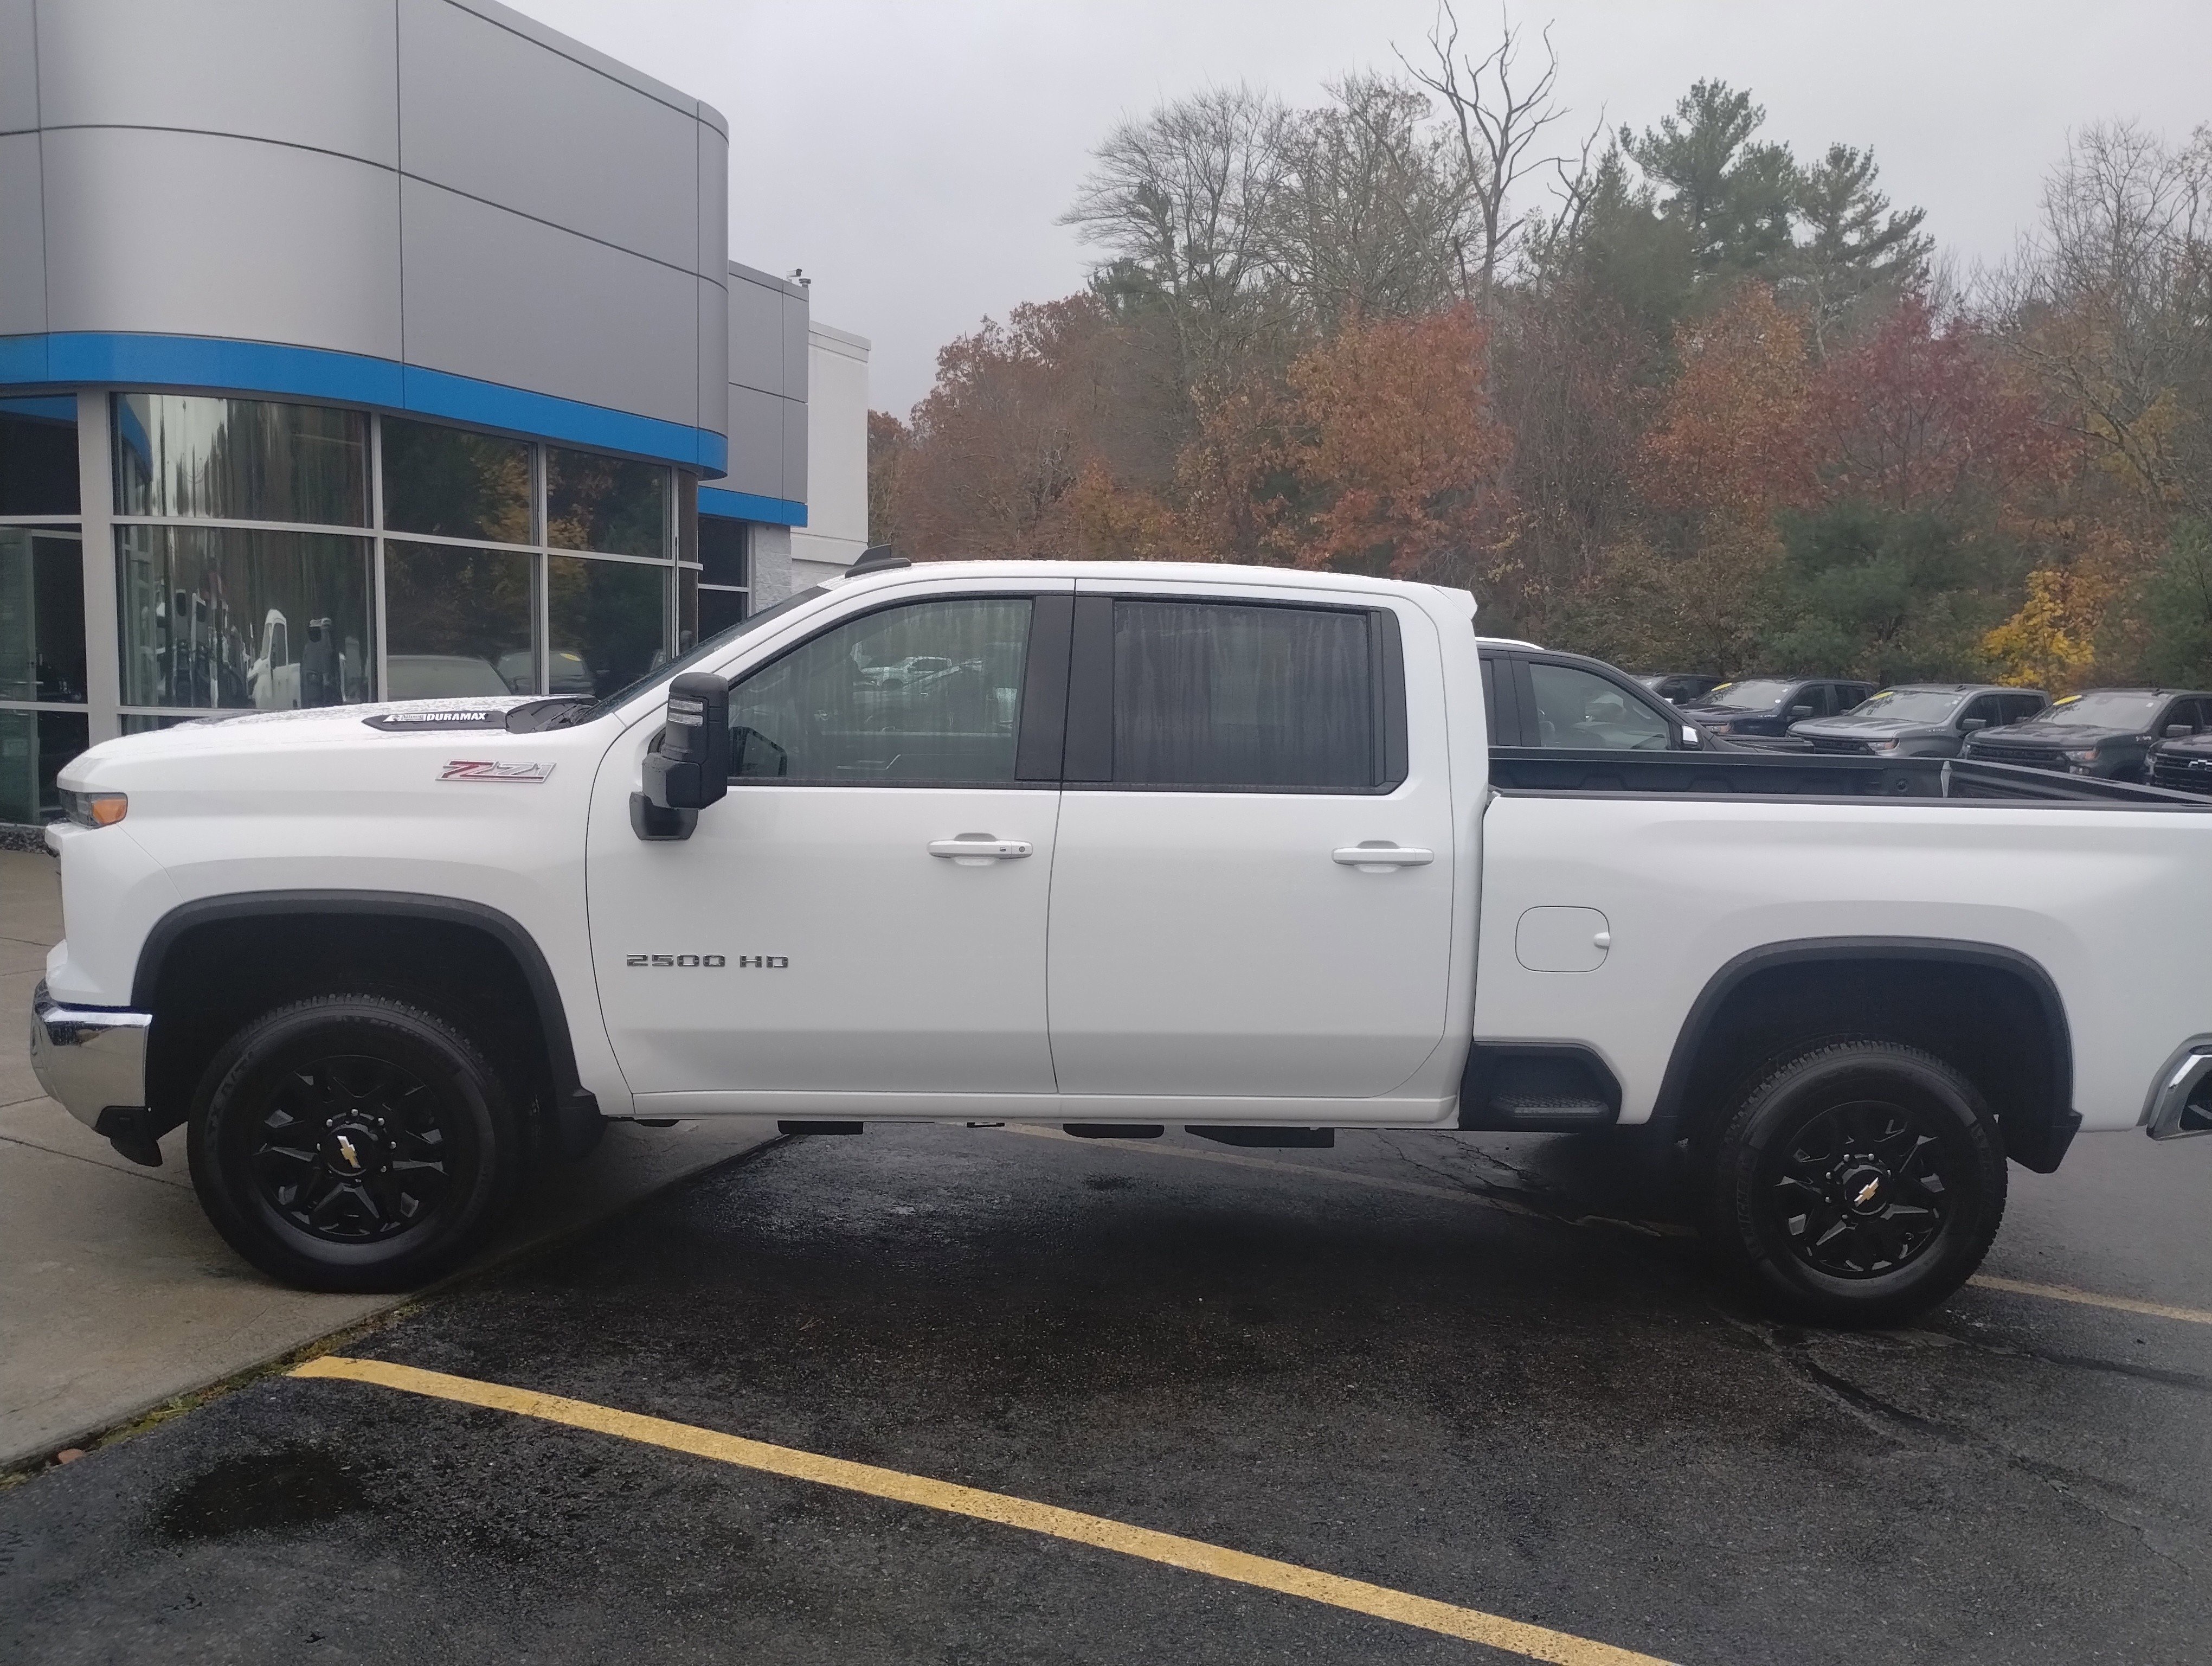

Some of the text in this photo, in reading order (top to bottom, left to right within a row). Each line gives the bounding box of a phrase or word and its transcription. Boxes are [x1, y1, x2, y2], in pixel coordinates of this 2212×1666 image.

[426, 713, 487, 721] DURAMAX
[435, 759, 557, 783] Z71
[626, 953, 789, 968] 2500 HD
